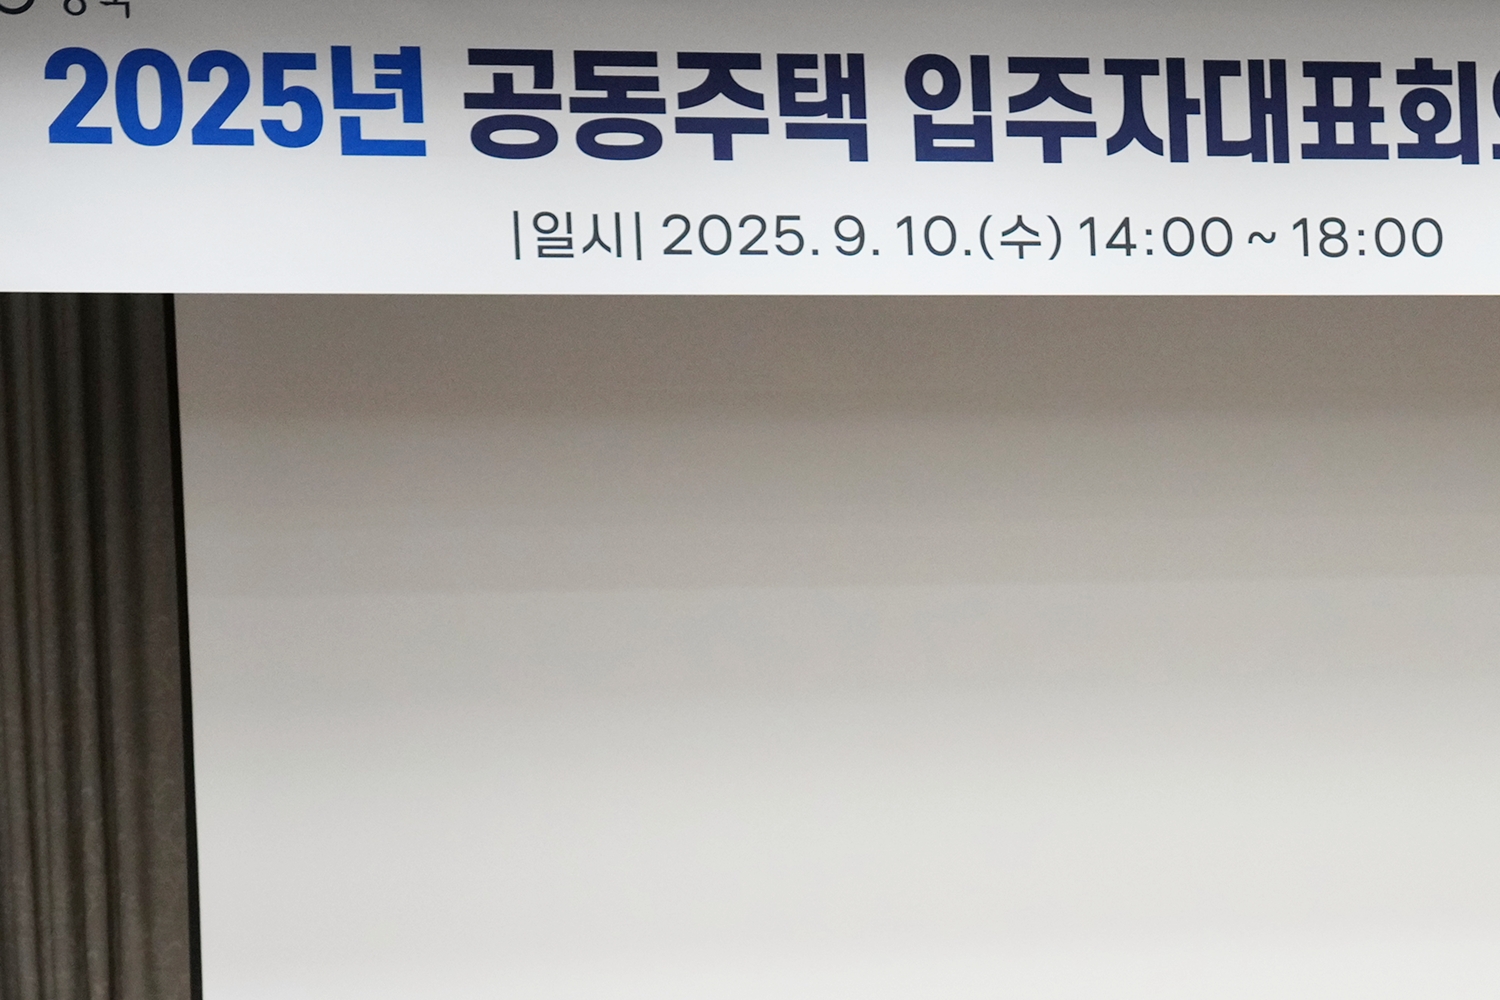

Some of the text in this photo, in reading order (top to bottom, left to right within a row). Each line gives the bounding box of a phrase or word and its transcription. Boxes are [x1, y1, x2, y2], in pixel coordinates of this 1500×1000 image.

[43, 45, 428, 157] 2025년
[463, 47, 870, 163] 공동주택
[661, 213, 820, 257] 2025.
